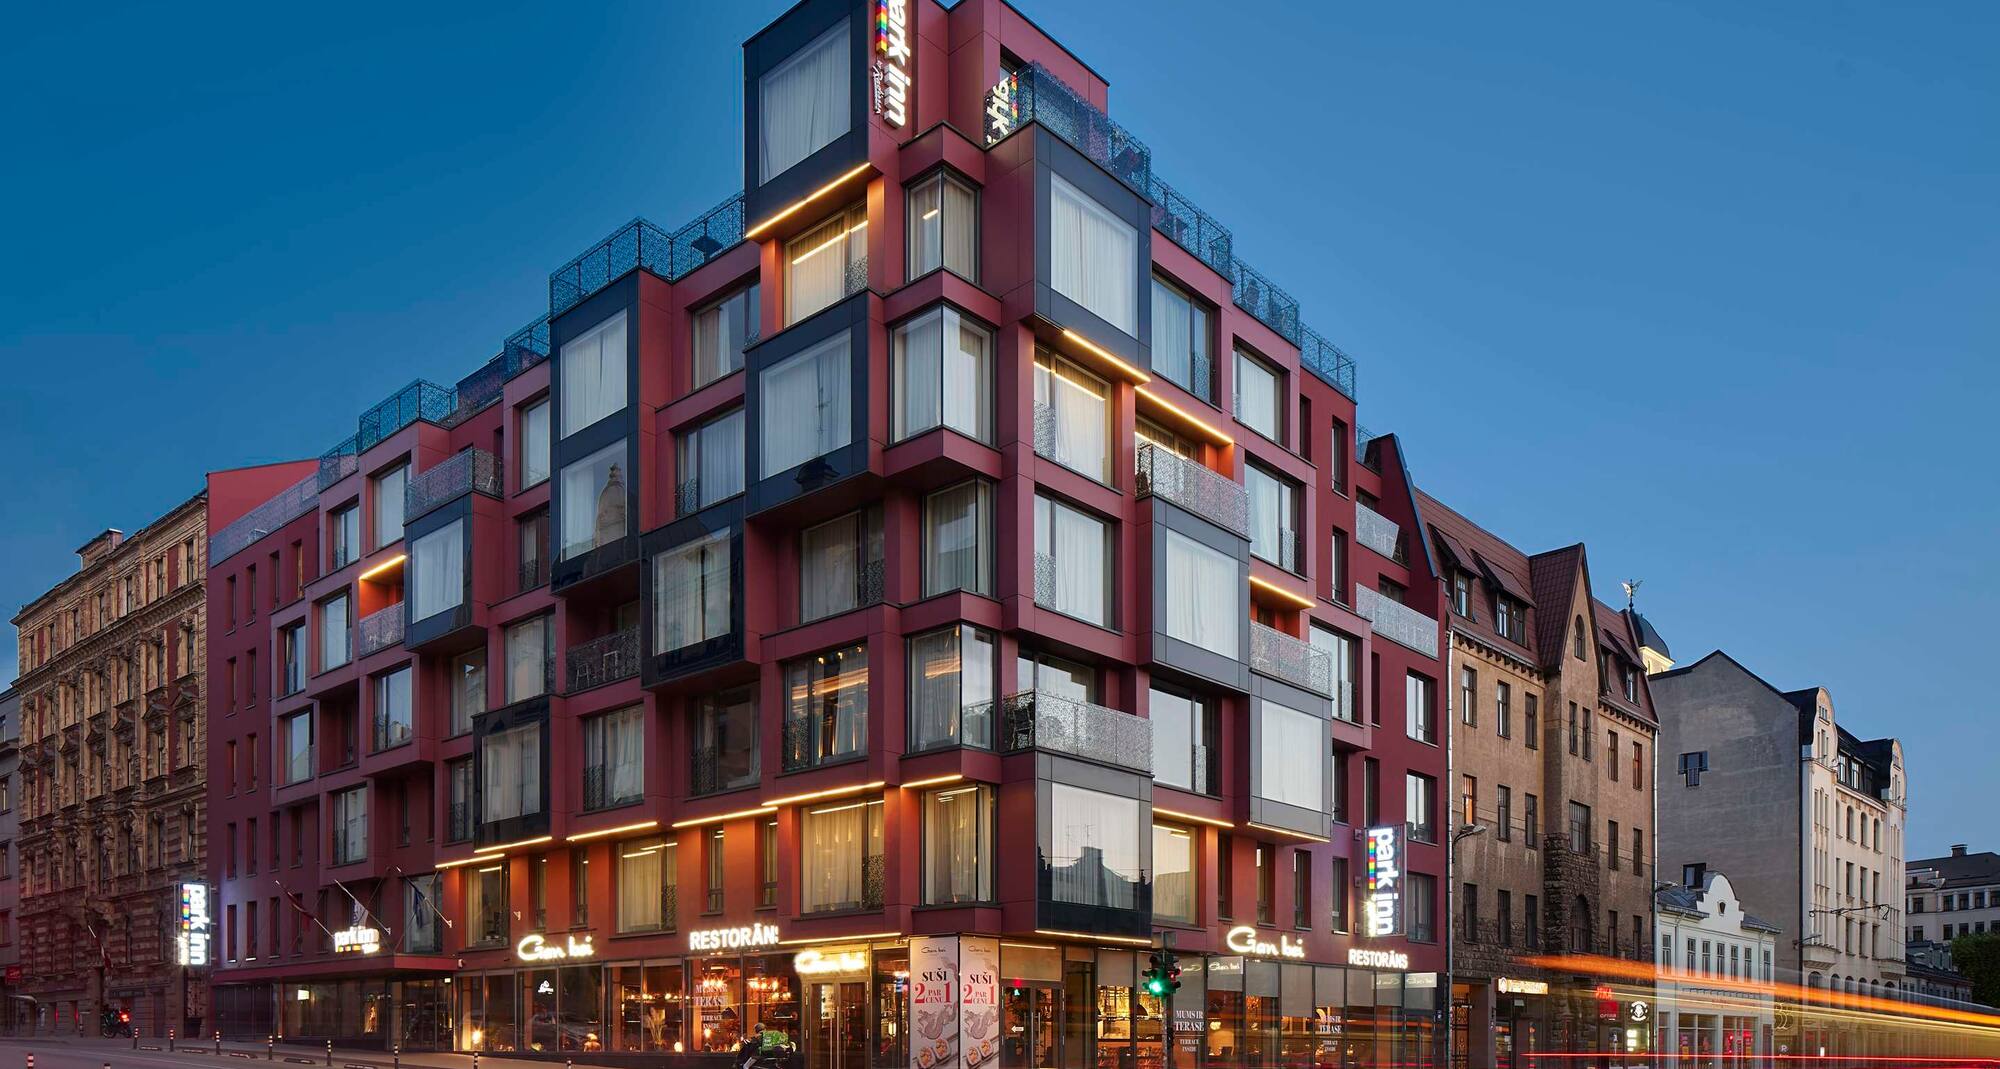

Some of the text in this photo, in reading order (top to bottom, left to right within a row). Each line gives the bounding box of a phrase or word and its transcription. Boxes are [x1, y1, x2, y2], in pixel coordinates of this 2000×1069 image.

[885, 0, 911, 127] ark inn
[1368, 827, 1399, 890] park
[183, 883, 210, 930] park
[1376, 892, 1399, 935] inn
[190, 932, 210, 965] inn
[1348, 948, 1409, 969] RESTORĀNS
[922, 968, 947, 982] SUŠI
[969, 971, 992, 984] SUŠI
[914, 983, 926, 1004] 2
[944, 981, 951, 1003] 1
[963, 984, 973, 1004] 2
[989, 985, 995, 1004] 1
[1176, 1010, 1204, 1019] MUMS IR
[1174, 1021, 1205, 1032] TERASE
